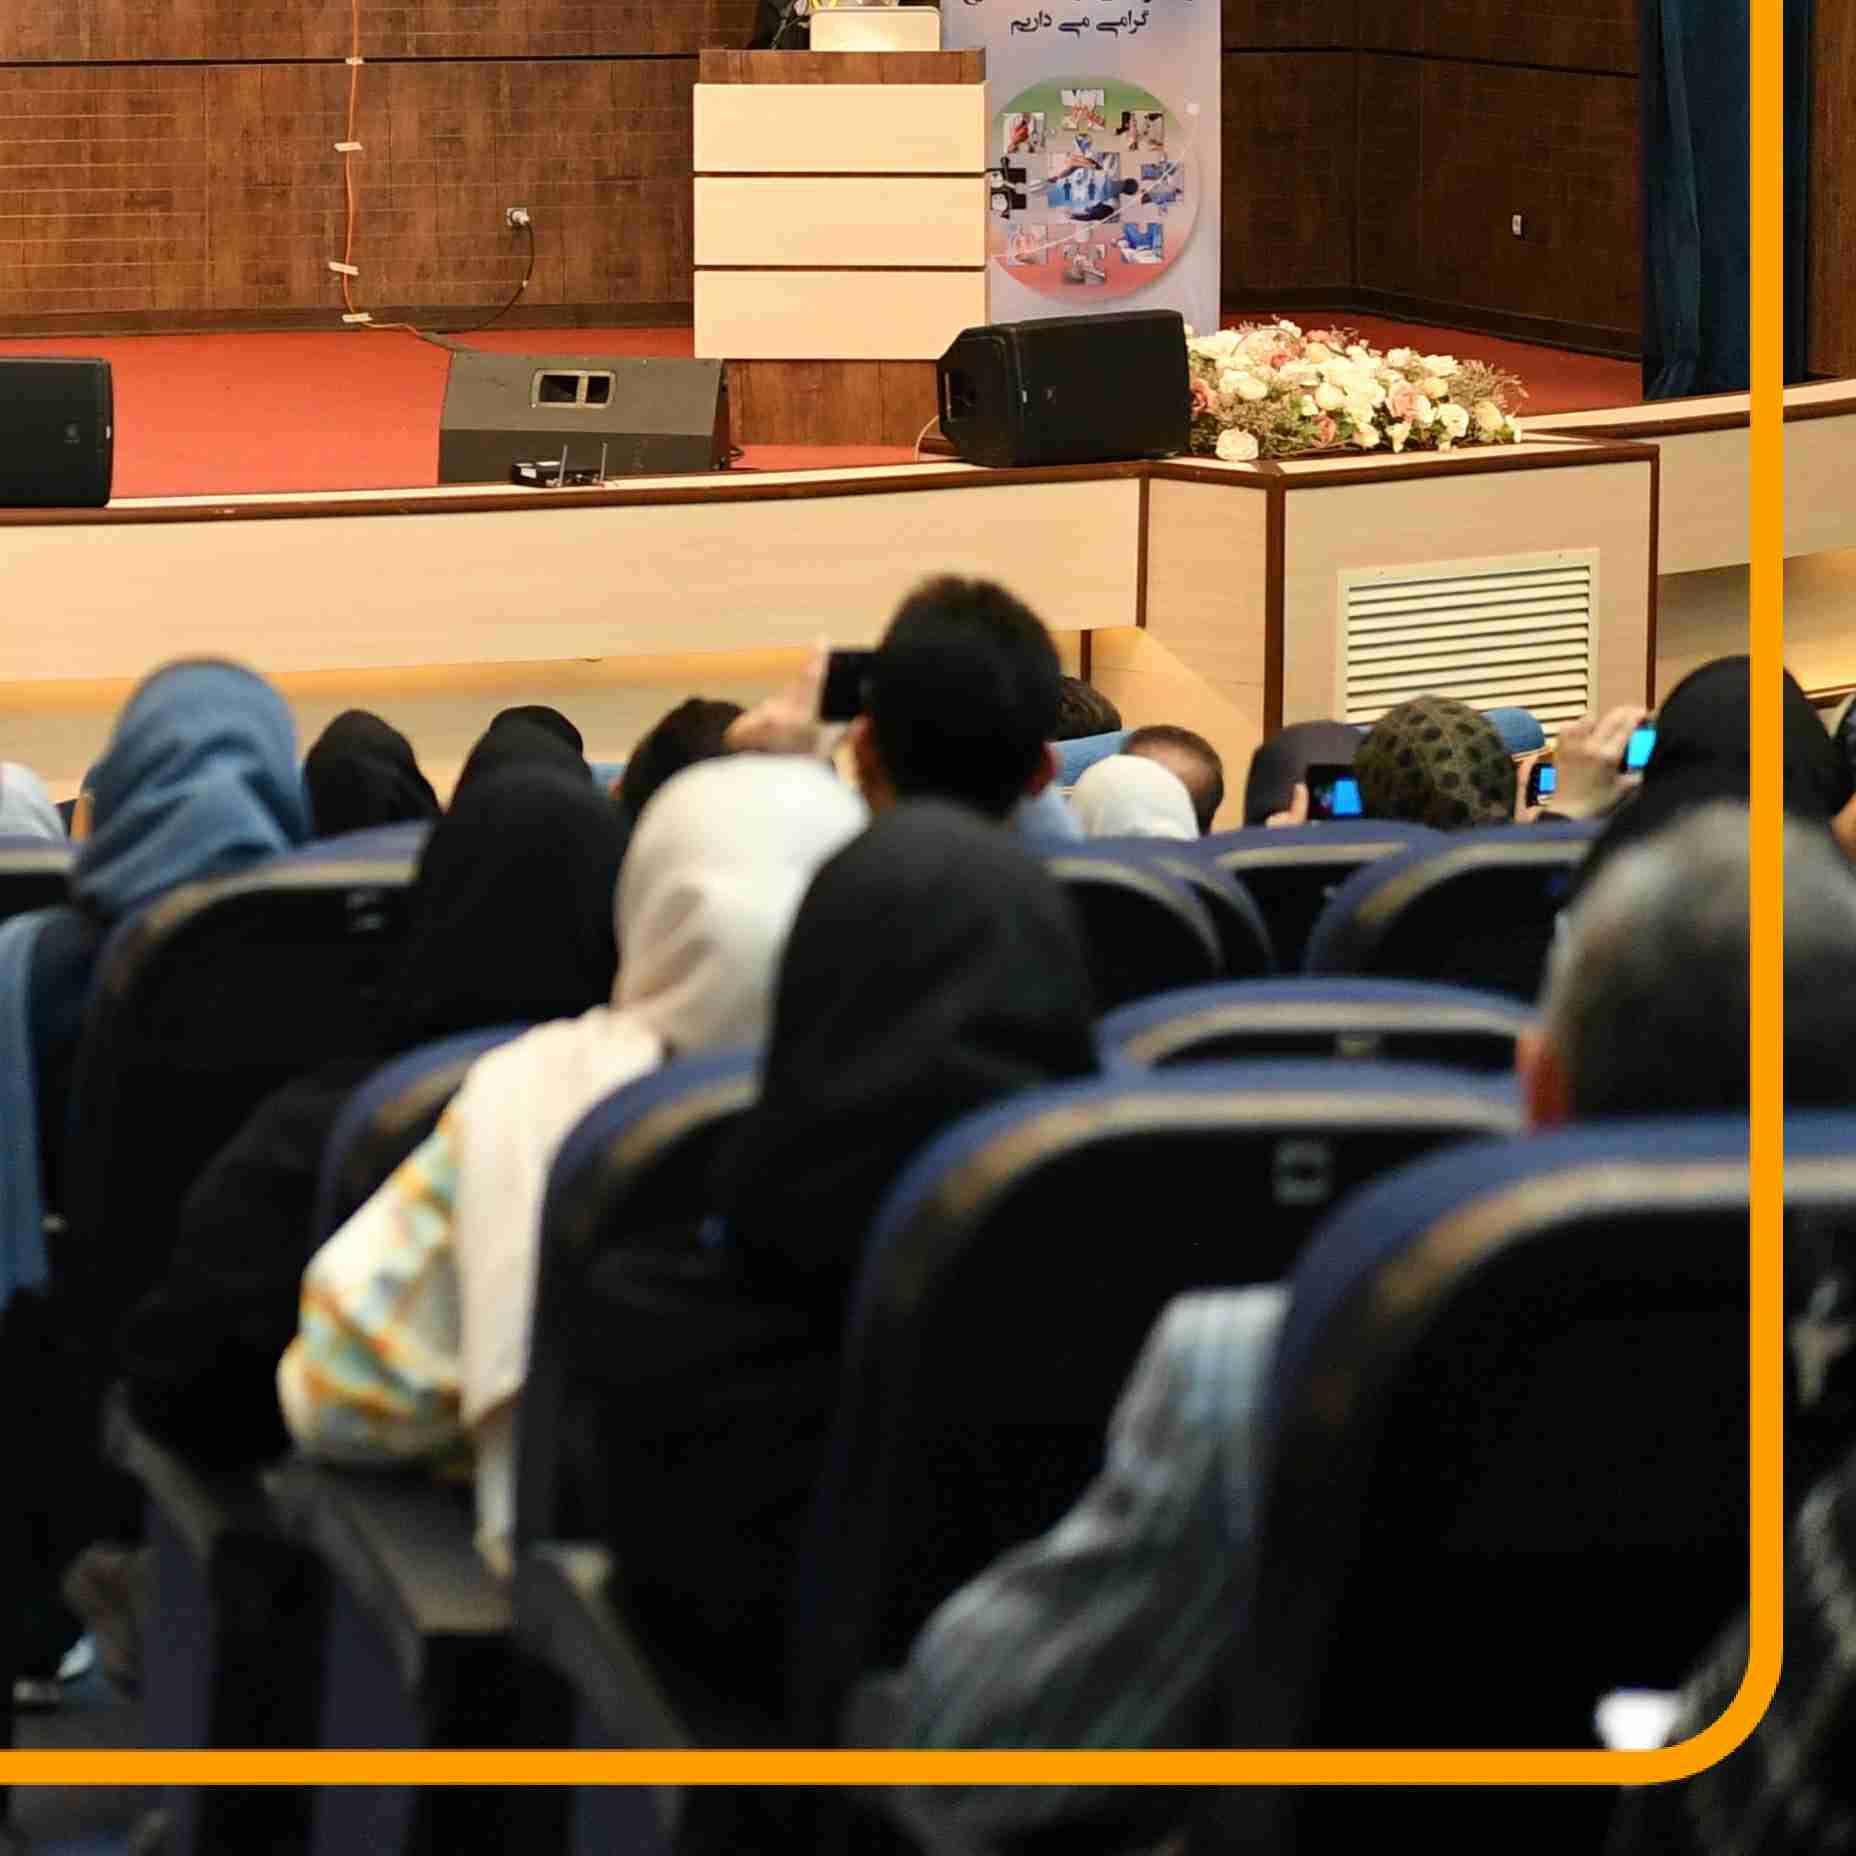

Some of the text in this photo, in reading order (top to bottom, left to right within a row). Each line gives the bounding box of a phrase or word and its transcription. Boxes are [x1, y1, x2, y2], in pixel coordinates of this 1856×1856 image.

[1010, 10, 1149, 38] گرامی می داریم
